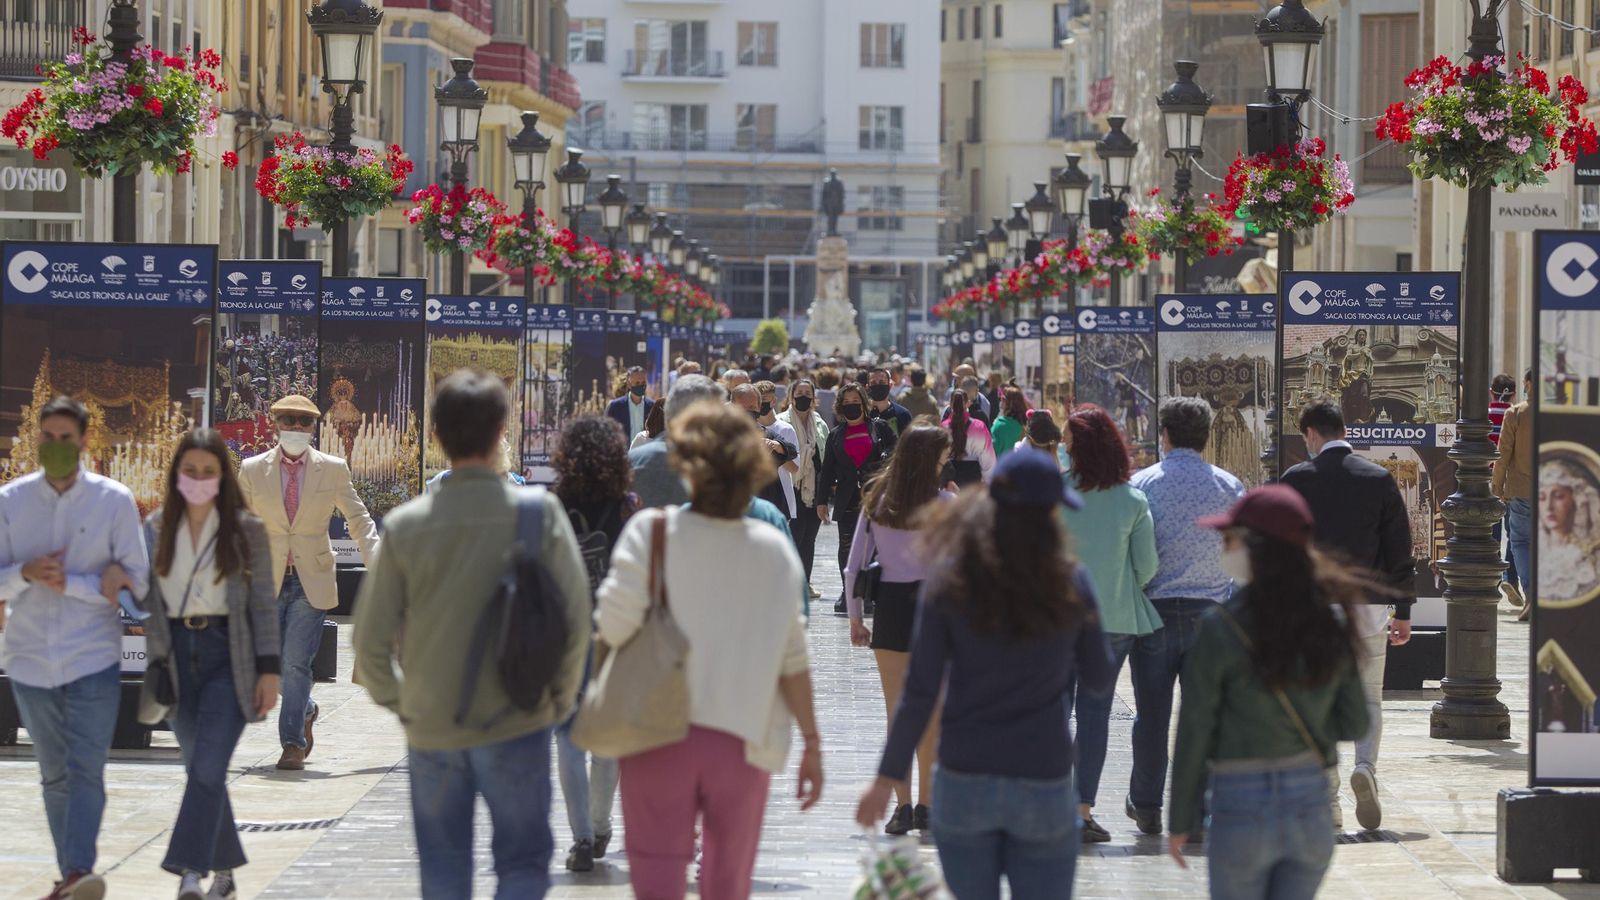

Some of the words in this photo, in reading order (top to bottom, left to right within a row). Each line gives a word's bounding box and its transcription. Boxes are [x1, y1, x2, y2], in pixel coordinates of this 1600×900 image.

[0, 166, 67, 192] OYSHO
[51, 262, 79, 273] COPE
[75, 291, 91, 300] LOS
[93, 291, 126, 301] TRONOS
[126, 292, 134, 301] A
[135, 292, 145, 301] LA
[1324, 289, 1347, 298] COPE
[220, 301, 247, 309] TRONOS
[248, 301, 254, 309] A
